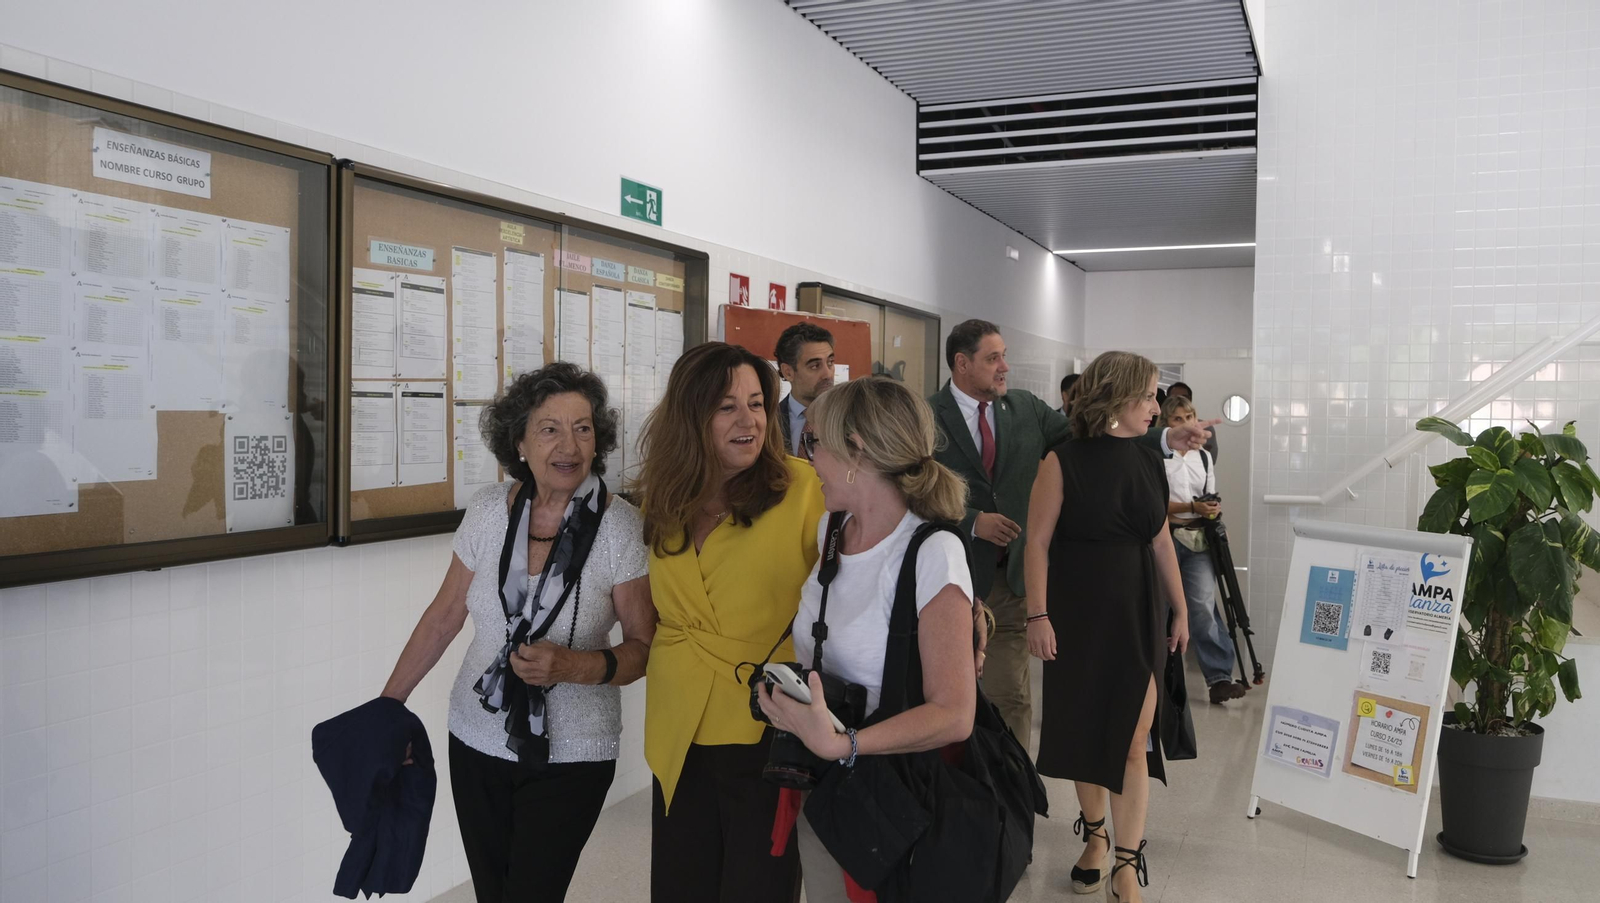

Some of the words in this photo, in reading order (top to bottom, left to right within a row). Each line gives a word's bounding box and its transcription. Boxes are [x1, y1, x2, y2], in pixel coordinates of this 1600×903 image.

[106, 140, 166, 161] ENSEÑANZAS
[167, 153, 200, 169] BÁSICAS
[100, 159, 141, 176] NOMBRE
[143, 168, 173, 182] CURSO
[176, 175, 205, 188] GRUPO
[378, 243, 427, 259] ENSEÑANZAS
[386, 255, 418, 267] BASICAS
[601, 260, 616, 270] DANZA
[596, 268, 620, 280] ESPAÑOLA
[633, 267, 648, 276] DANZA
[826, 528, 839, 561] Canon
[1371, 720, 1393, 732] HORARIO
[1393, 726, 1407, 736] AMPA
[1370, 729, 1386, 741] CURSO
[1387, 735, 1403, 746] 24/25
[1296, 756, 1324, 768] GRACIAS
